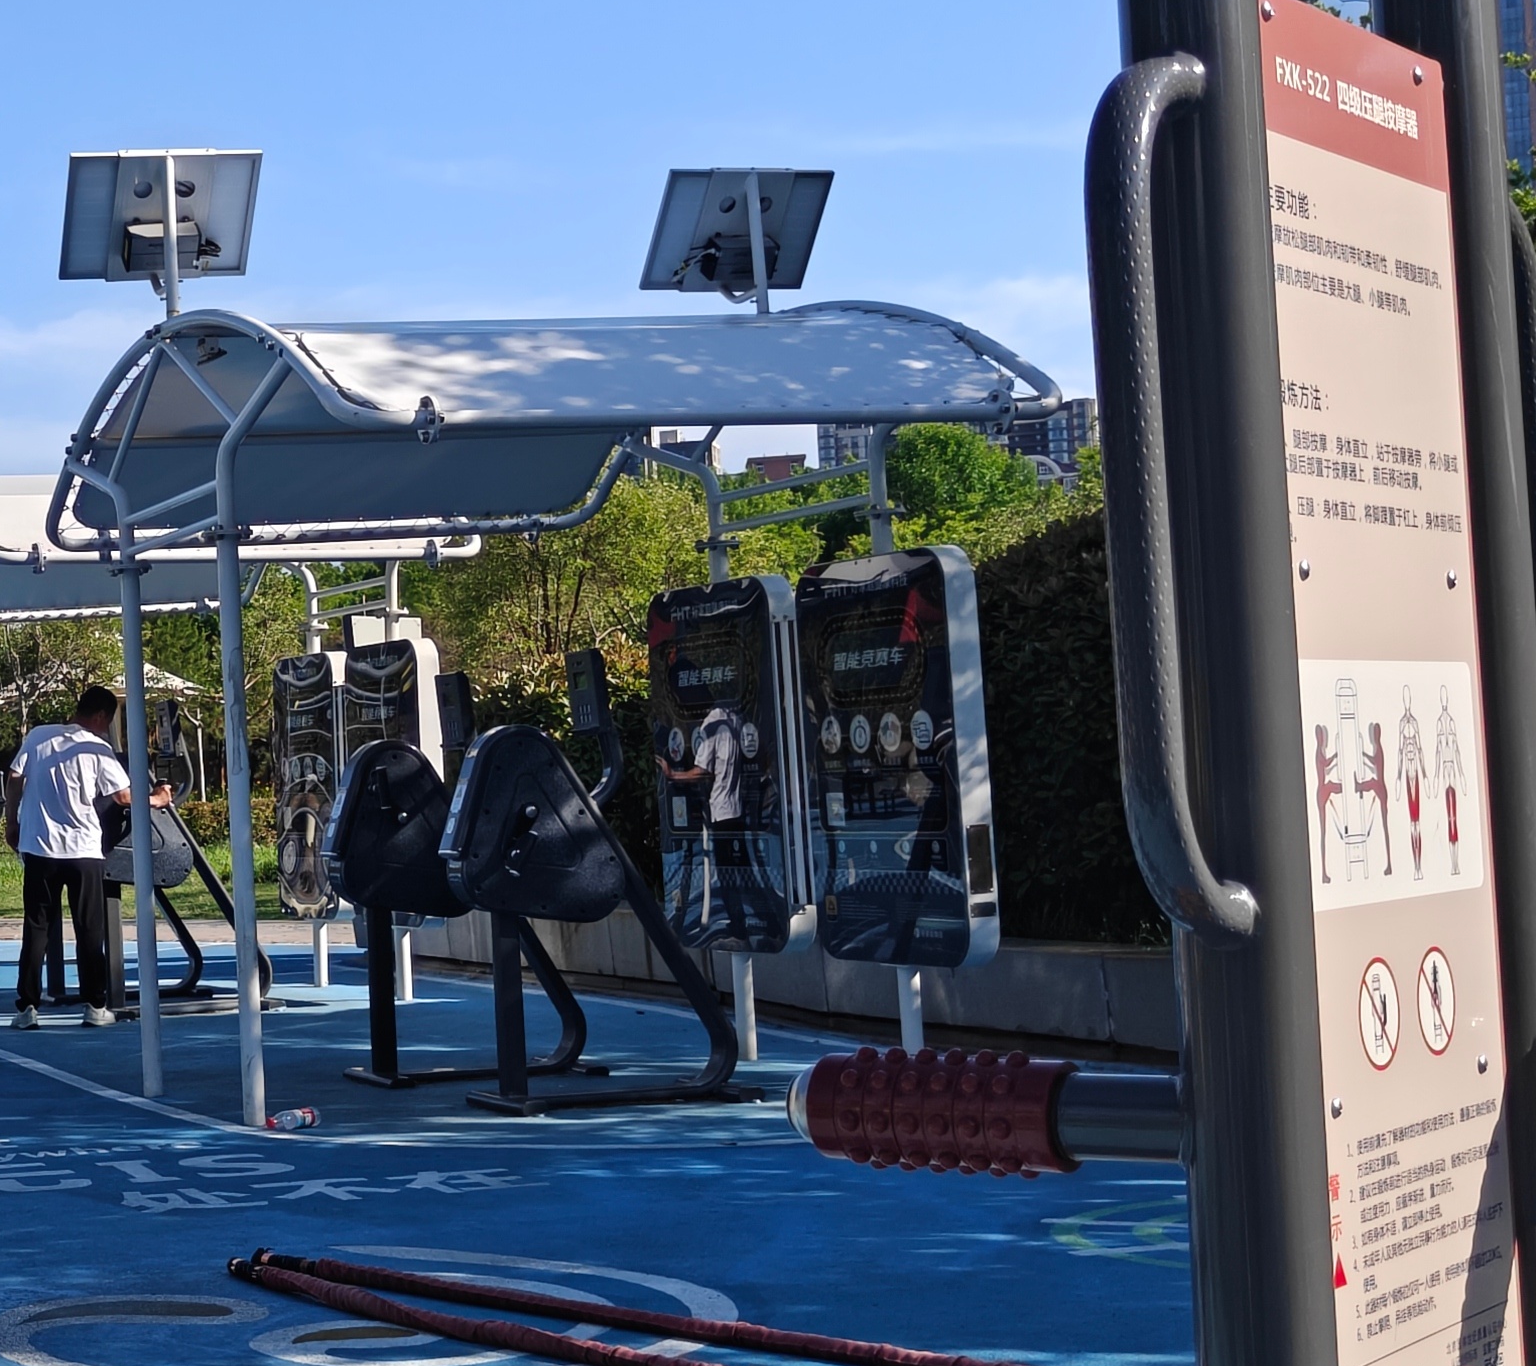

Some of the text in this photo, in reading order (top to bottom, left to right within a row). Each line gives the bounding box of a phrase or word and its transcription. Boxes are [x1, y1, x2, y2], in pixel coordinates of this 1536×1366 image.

[1275, 56, 1419, 140] FXK-522 四级压腿按摩器
[1273, 262, 1412, 317] 摩肌肉部位主要是大腿、小腿等肌肉。
[833, 646, 908, 672] 智能竞赛车
[95, 1153, 296, 1183] IS
